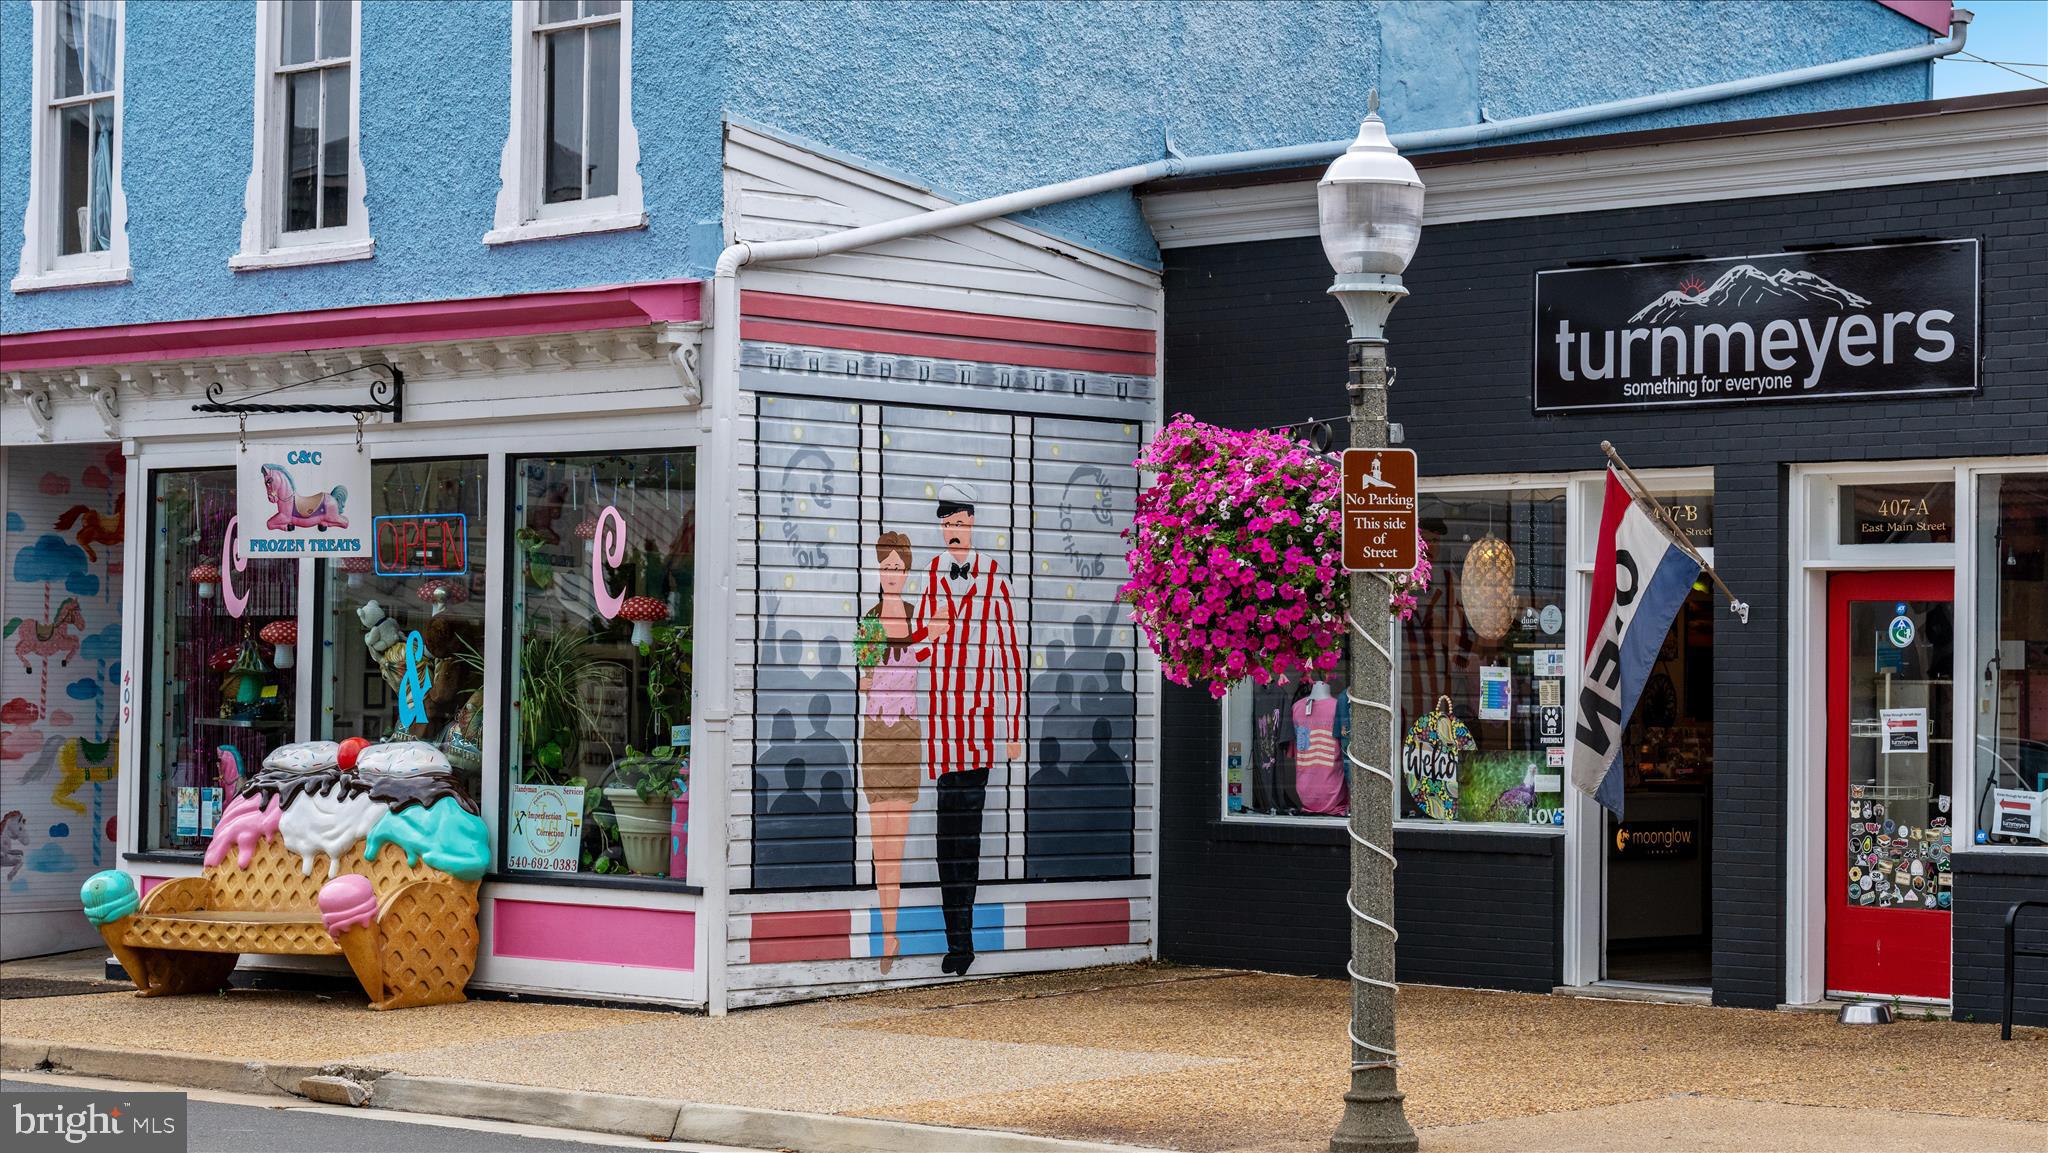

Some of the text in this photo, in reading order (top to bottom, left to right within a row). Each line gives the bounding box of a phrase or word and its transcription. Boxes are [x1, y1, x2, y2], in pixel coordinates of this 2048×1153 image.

[1555, 309, 1956, 389] turnmeyers
[1623, 374, 1793, 397] something for everyone
[287, 450, 322, 466] C&C
[1345, 493, 1414, 510] No Parking
[1878, 498, 1930, 517] 407-A
[1353, 517, 1407, 529] This side
[1862, 521, 1947, 533] East Main Street
[1373, 532, 1388, 544] of
[1685, 527, 1713, 536] Street
[250, 538, 361, 552] FROZEN TREATS
[376, 519, 465, 571] OPEN
[1362, 546, 1398, 558] Street
[592, 505, 627, 620] C
[398, 629, 432, 729] &
[513, 785, 584, 796] Handyman Services
[528, 812, 562, 821] Imperfection
[536, 828, 565, 837] Correction
[1632, 827, 1691, 848] moonglow
[508, 856, 578, 871] 540-692-0383
